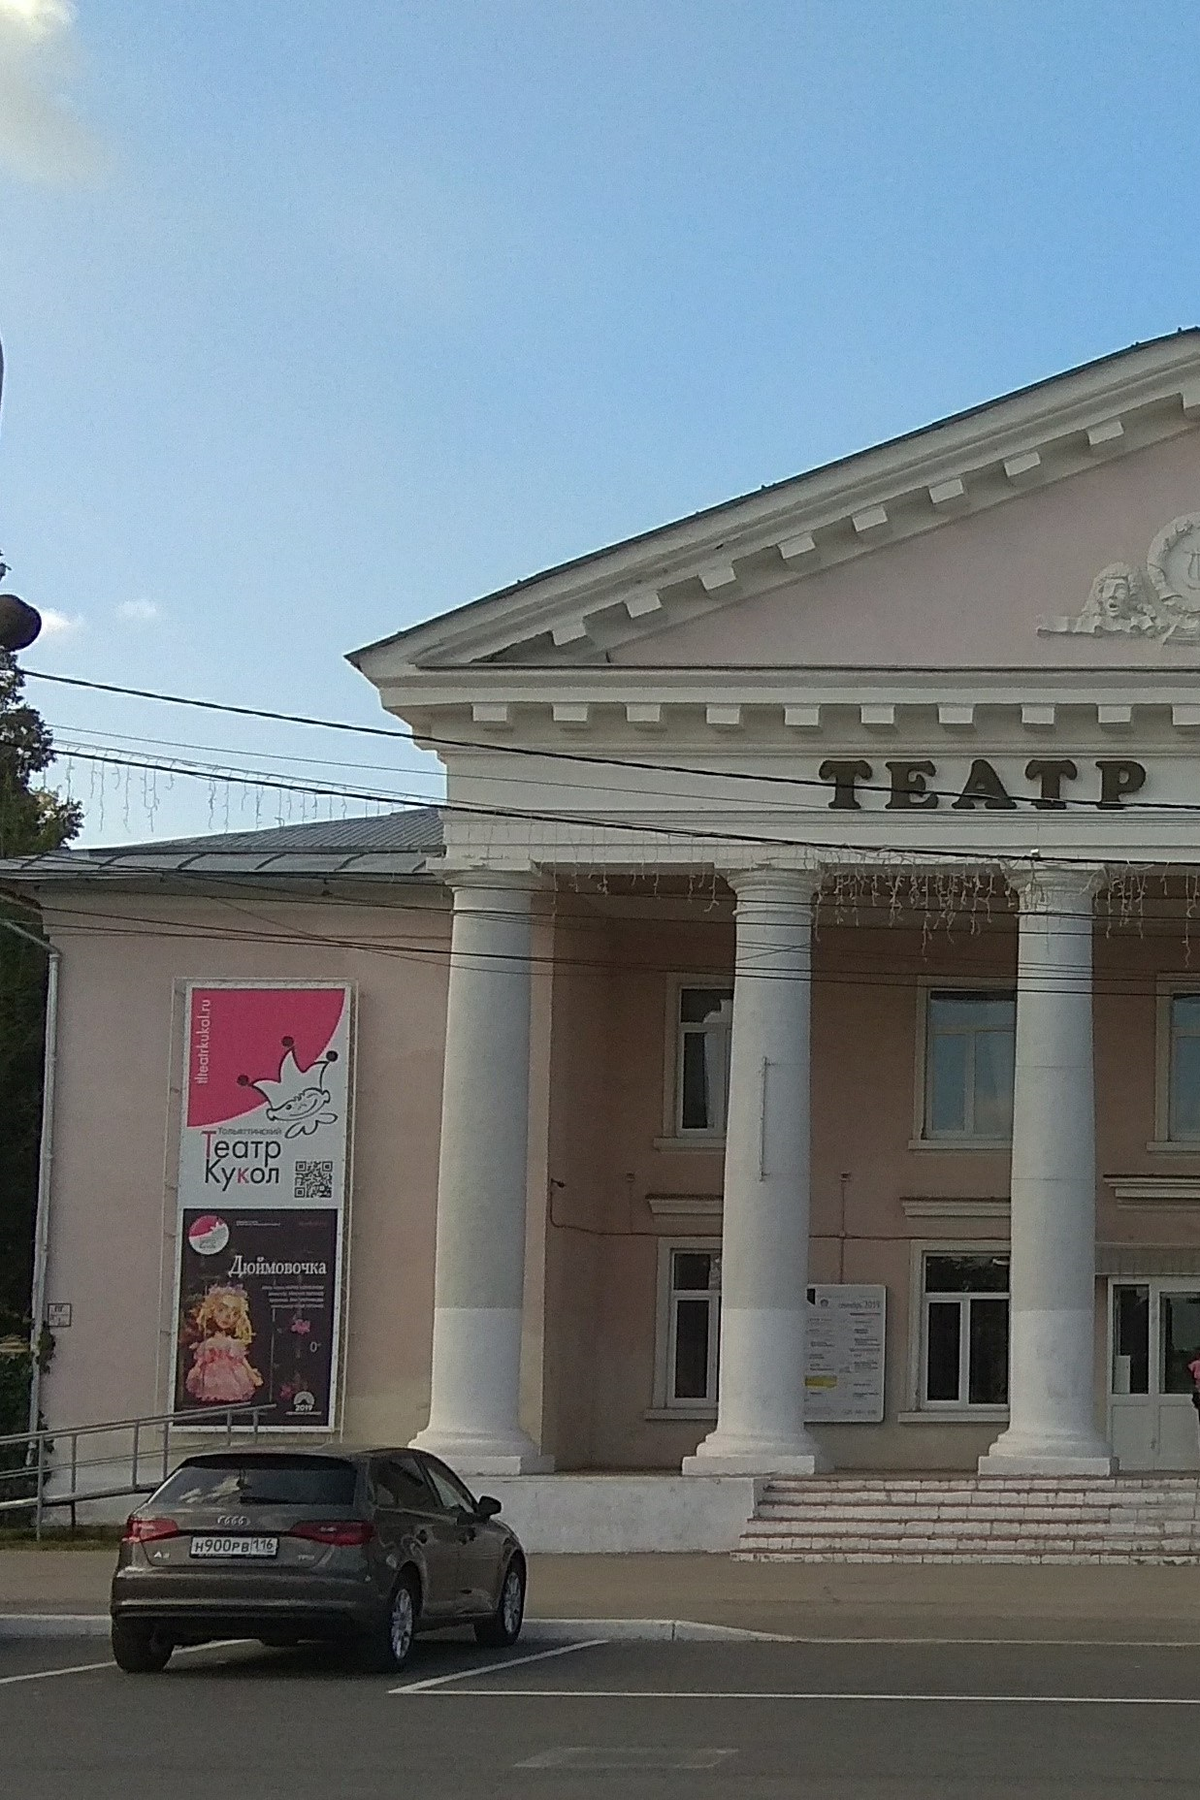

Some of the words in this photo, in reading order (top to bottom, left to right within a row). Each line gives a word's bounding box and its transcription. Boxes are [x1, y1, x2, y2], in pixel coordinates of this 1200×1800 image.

[818, 758, 1147, 811] ТЕАТР
[201, 1130, 281, 1168] Театр
[204, 1158, 279, 1192] Кукол
[227, 1254, 327, 1278] Дюймовочка
[252, 1539, 274, 1550] 116
